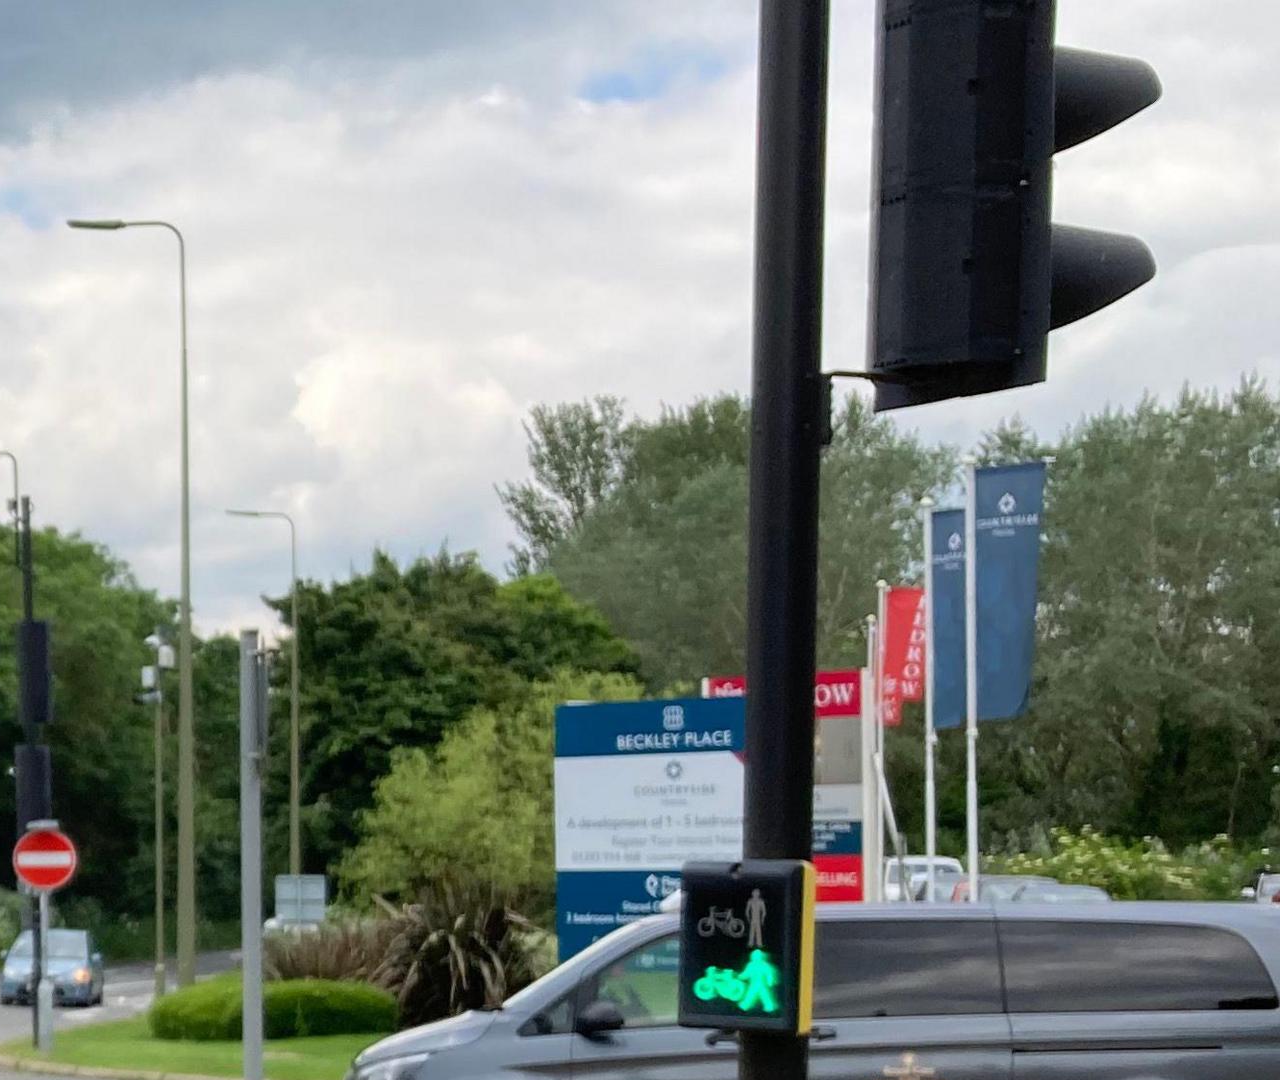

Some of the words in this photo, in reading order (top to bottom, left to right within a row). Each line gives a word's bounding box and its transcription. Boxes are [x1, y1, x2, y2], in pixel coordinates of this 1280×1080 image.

[814, 682, 854, 708] OW
[616, 733, 679, 751] BECKLEY
[684, 730, 732, 748] PLACE
